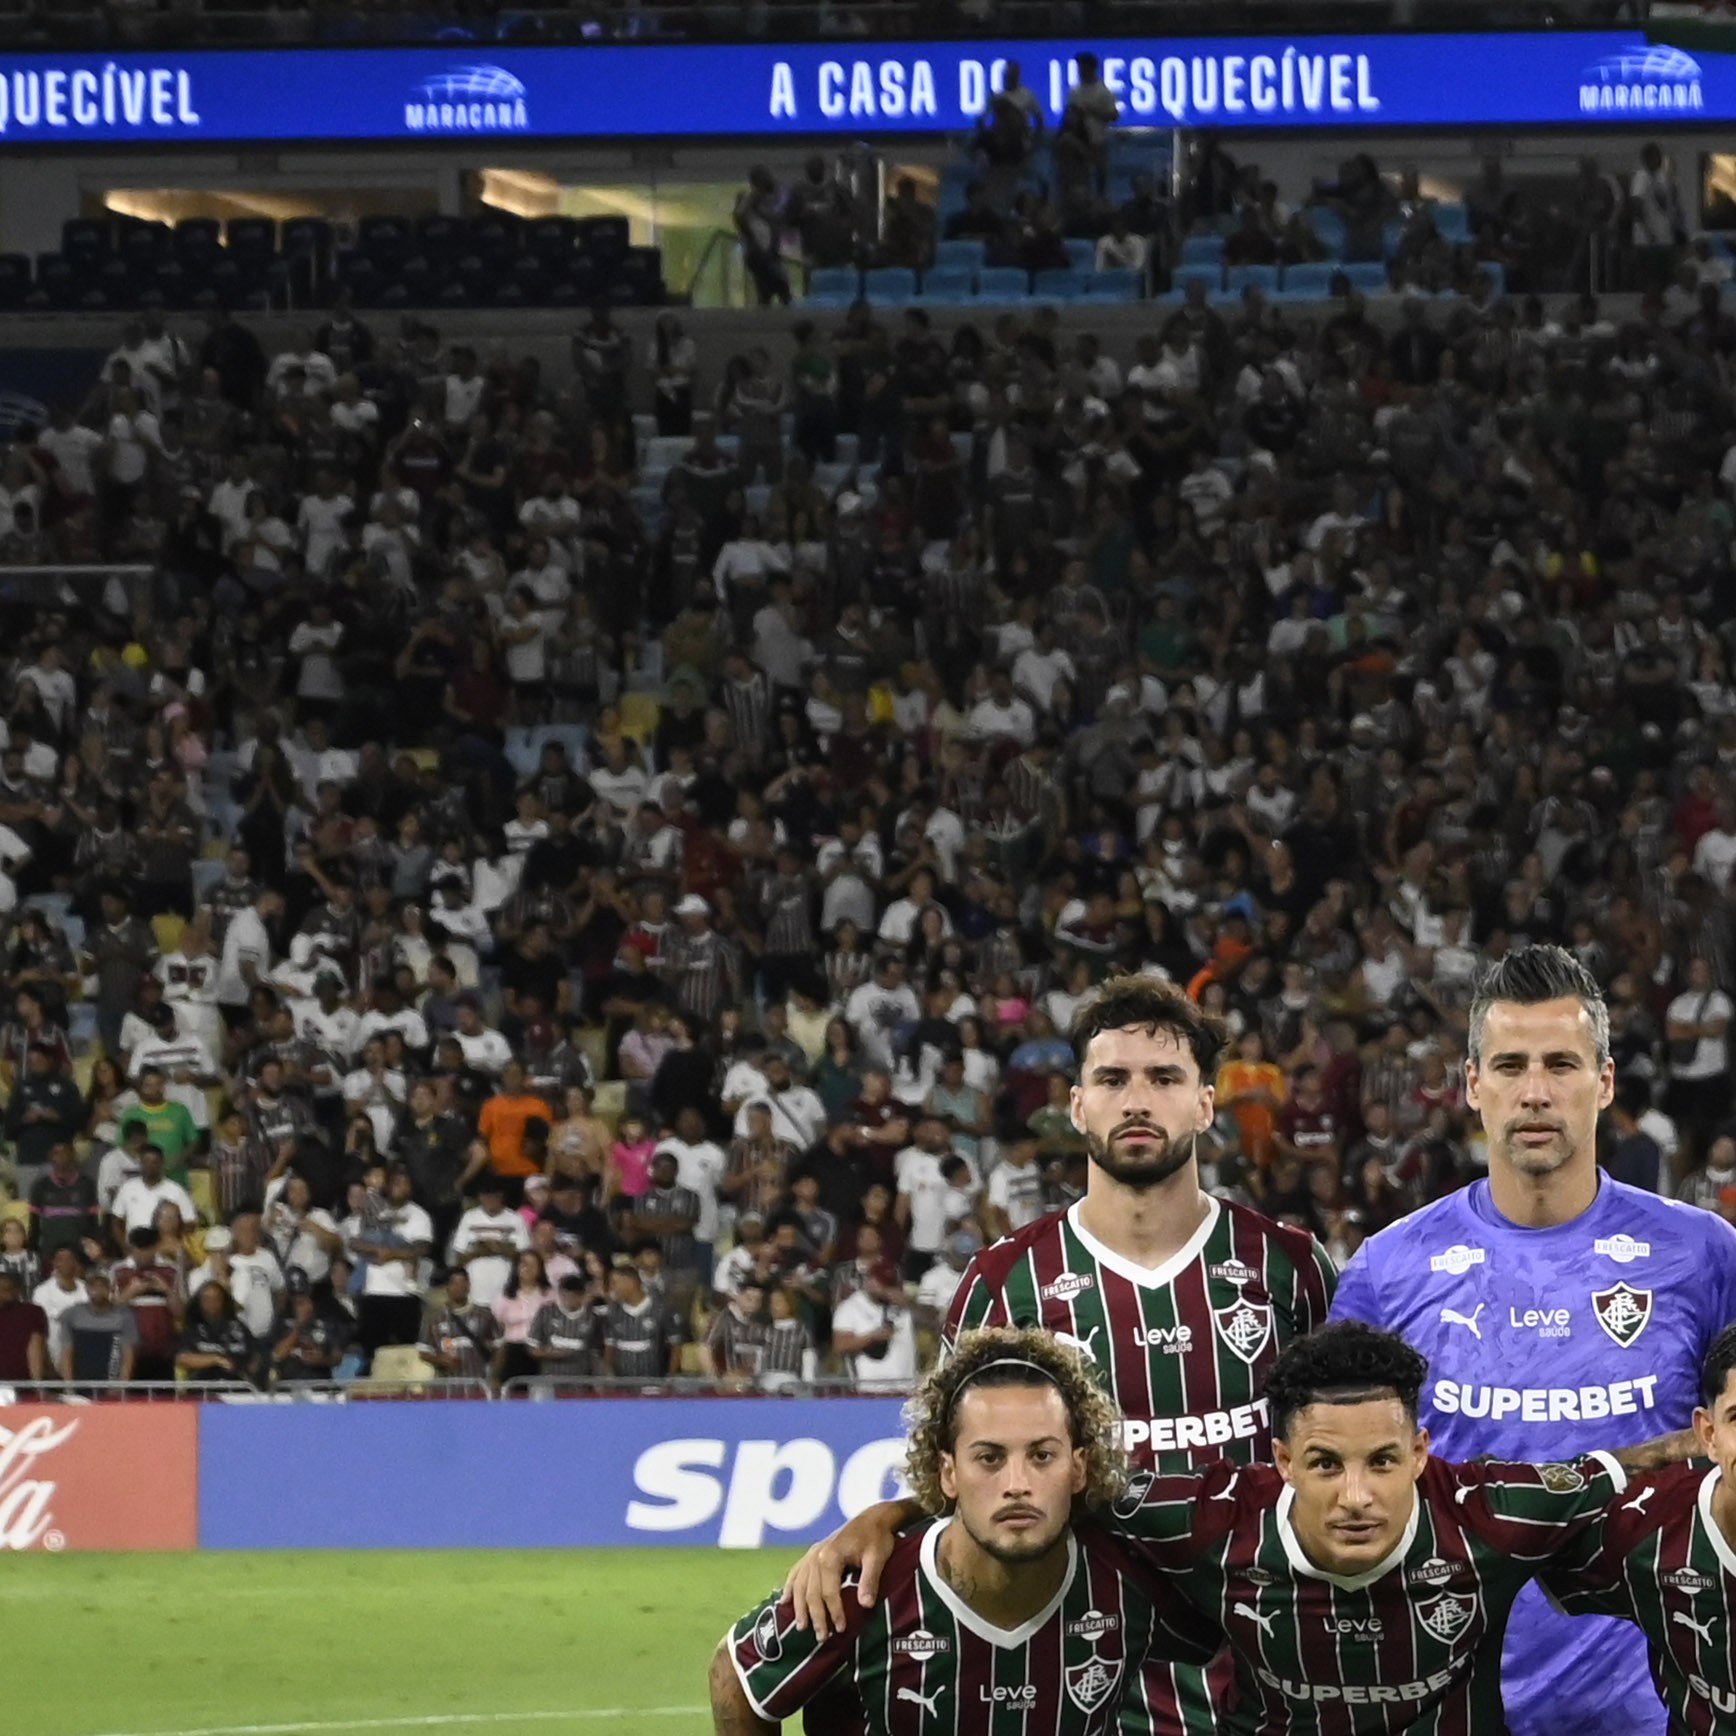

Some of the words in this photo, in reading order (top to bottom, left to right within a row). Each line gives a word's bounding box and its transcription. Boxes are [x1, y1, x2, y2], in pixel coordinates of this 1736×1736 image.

[771, 64, 797, 118] A
[820, 62, 937, 118] CASA
[1510, 1306, 1570, 1328] Leve
[1133, 1325, 1192, 1347] Leve
[1433, 1375, 1658, 1422] SUPERBET
[1323, 1616, 1383, 1634] Leve
[895, 1636, 949, 1651] FRESCATTO
[1258, 1656, 1468, 1703] SUPERBET
[979, 1684, 1038, 1702] Leve
